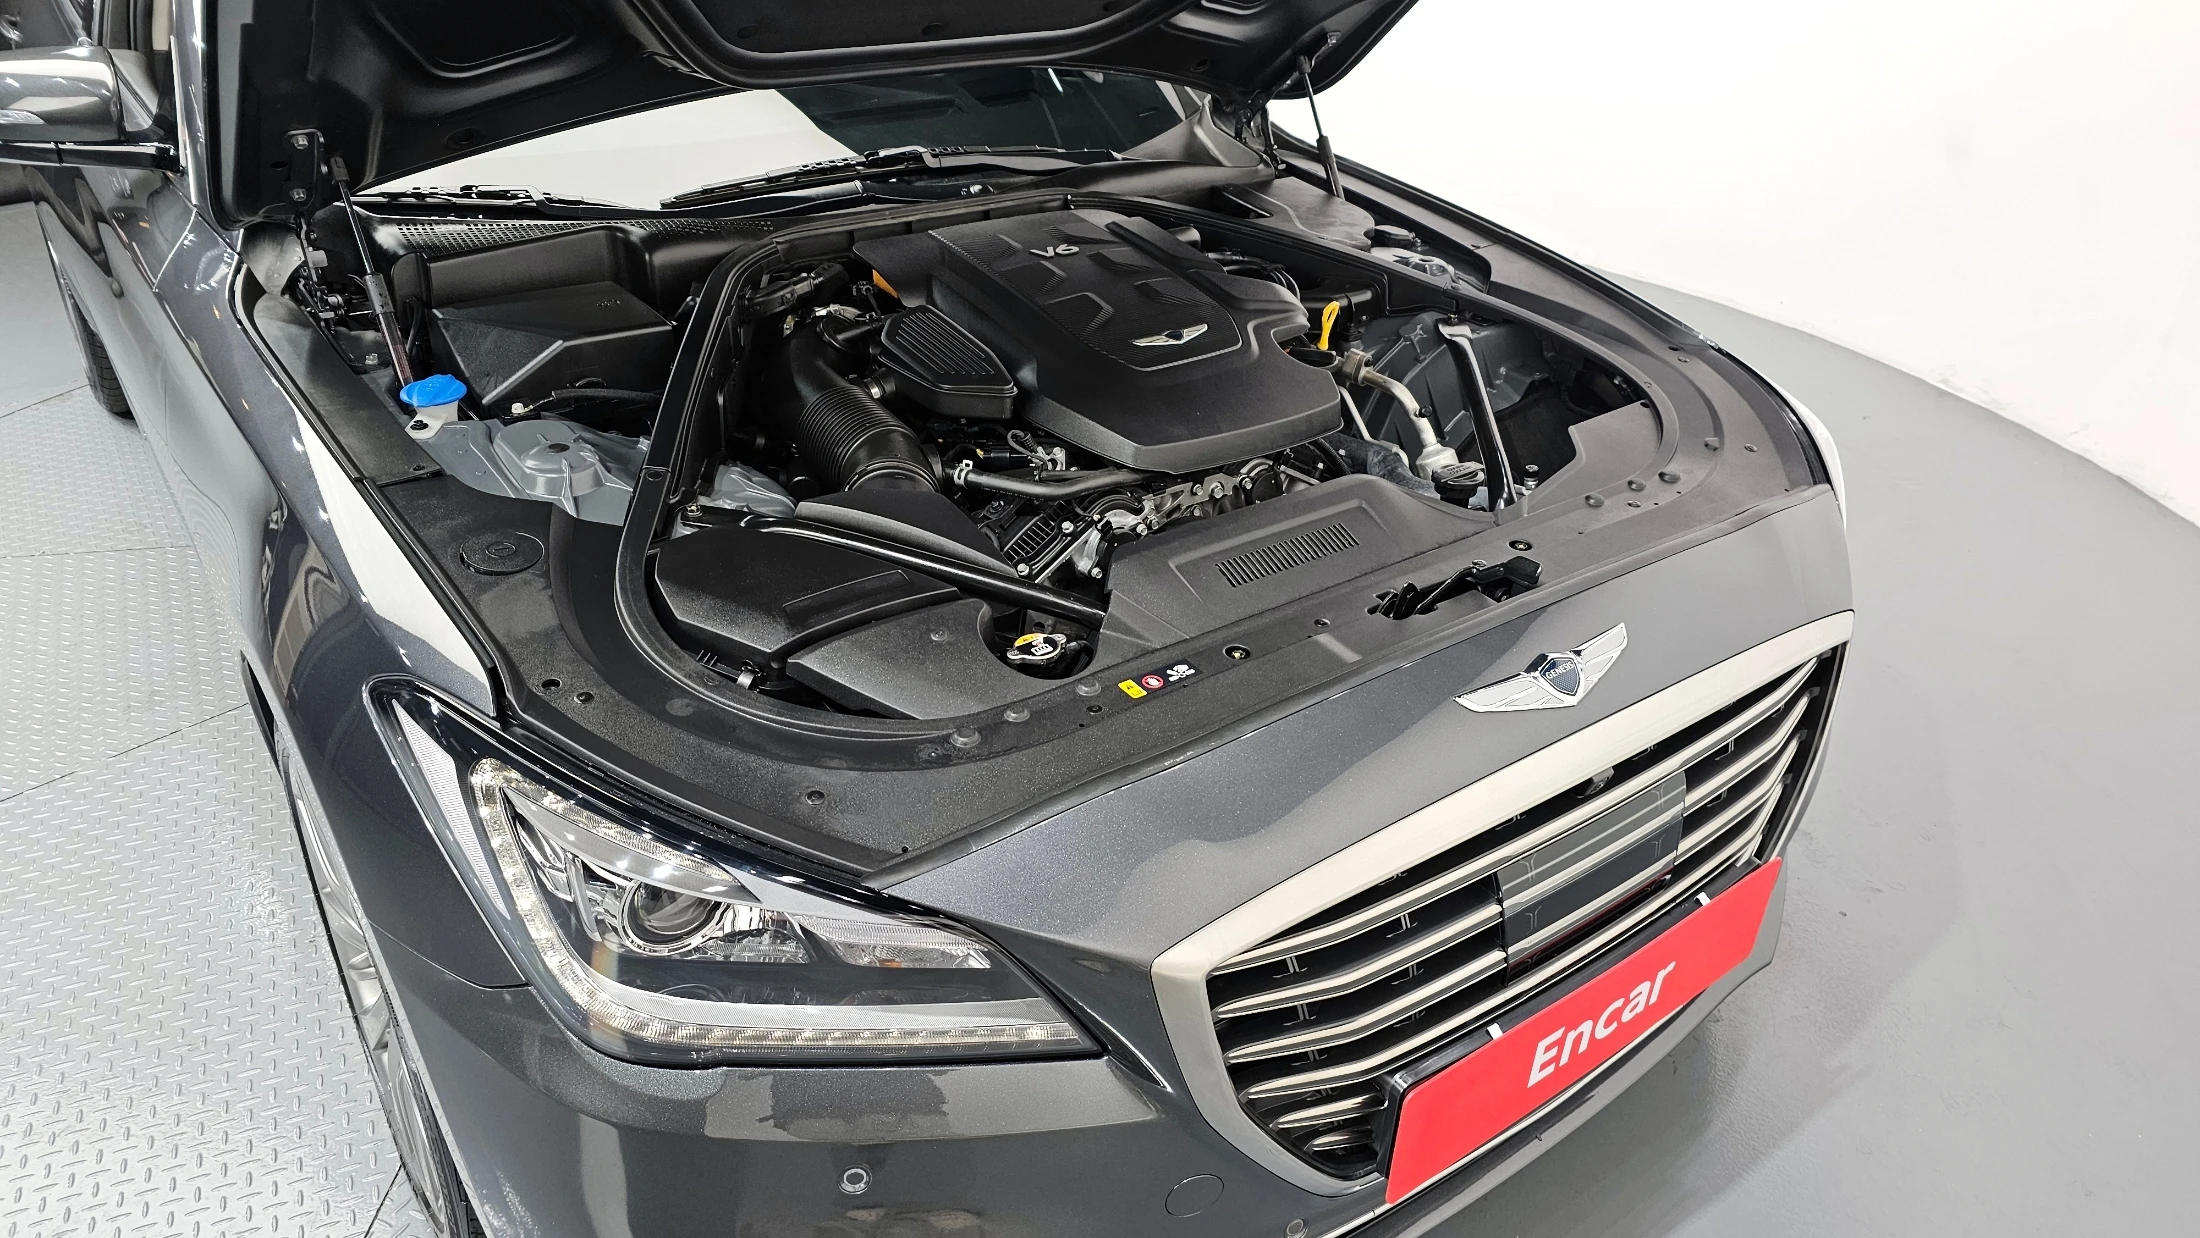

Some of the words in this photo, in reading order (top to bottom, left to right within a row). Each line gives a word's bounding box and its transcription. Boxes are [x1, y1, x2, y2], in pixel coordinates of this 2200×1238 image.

[1029, 244, 1079, 257] V6
[1545, 661, 1574, 678] GENESIS
[1527, 961, 1676, 1088] Encar
